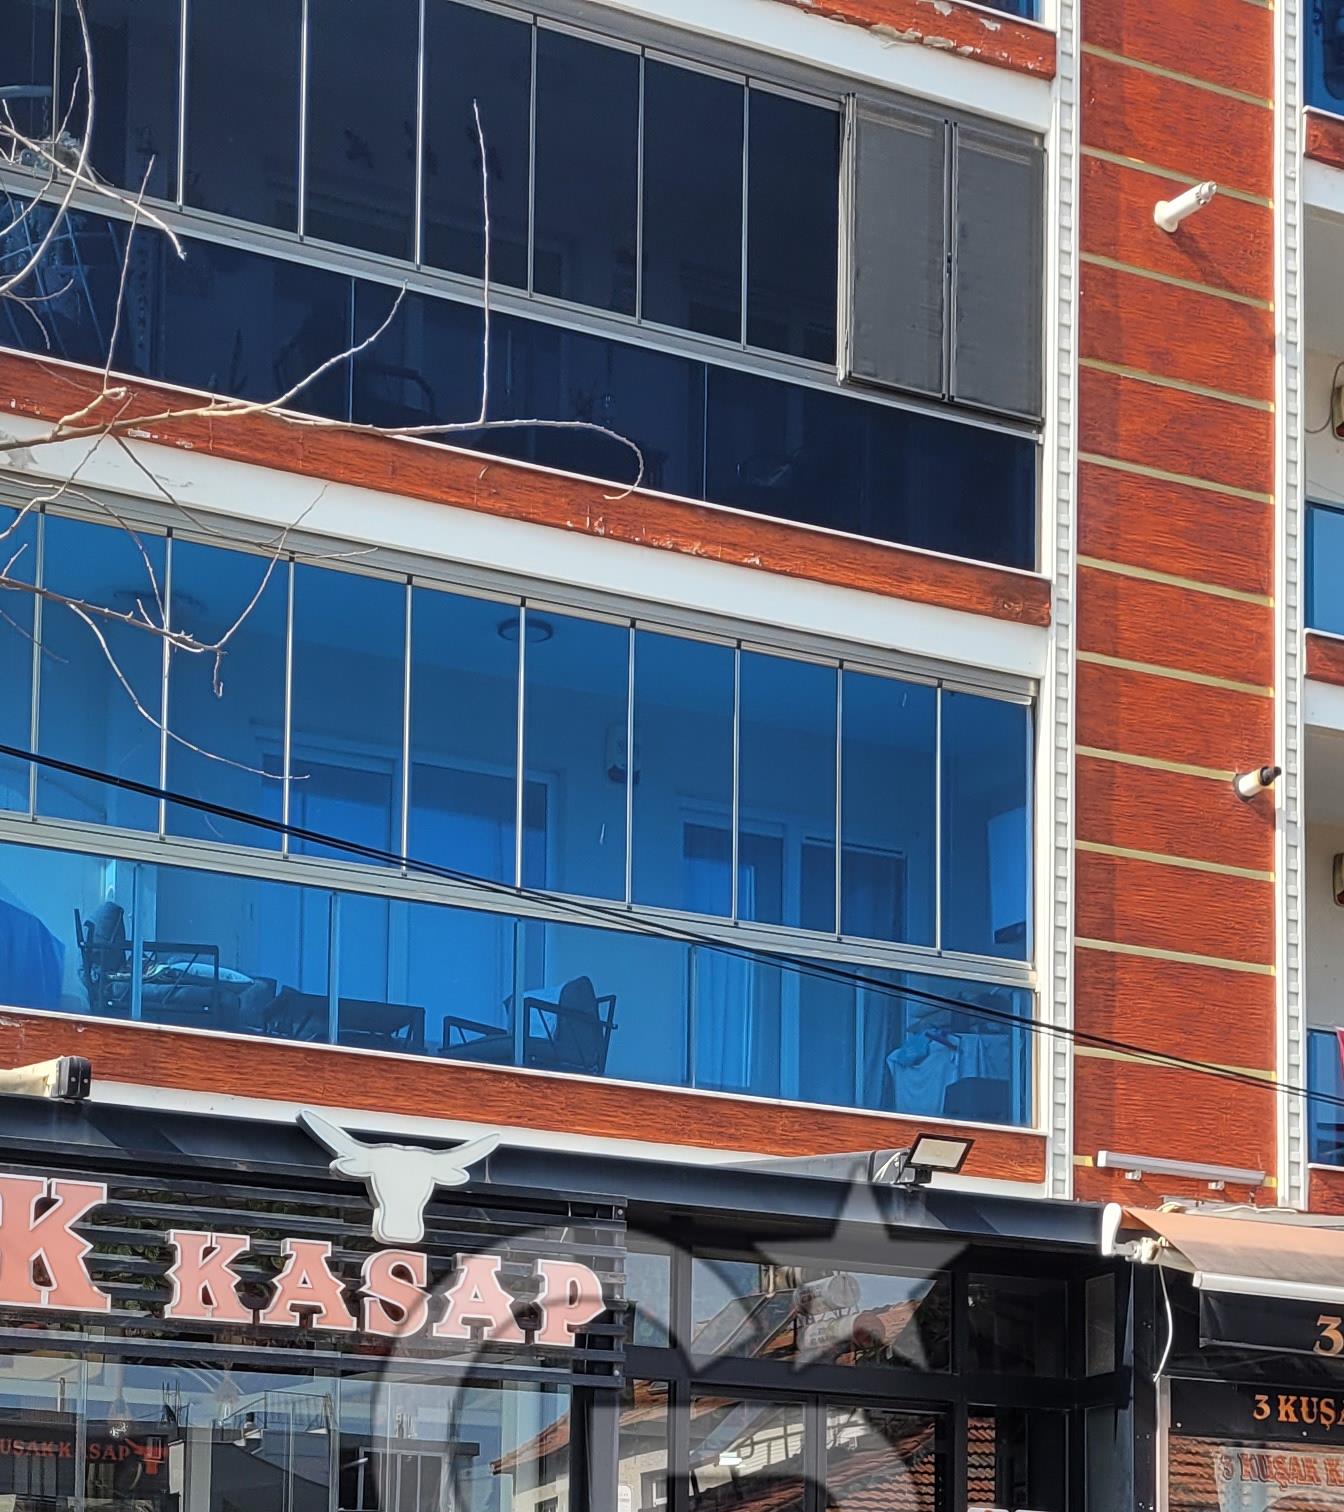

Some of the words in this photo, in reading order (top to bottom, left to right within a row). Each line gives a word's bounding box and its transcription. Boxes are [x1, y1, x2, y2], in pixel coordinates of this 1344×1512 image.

[165, 1228, 608, 1348] KASAP
[1312, 1314, 1344, 1357] 3
[1253, 1394, 1271, 1421] 3
[59, 1441, 129, 1462] KSAP
